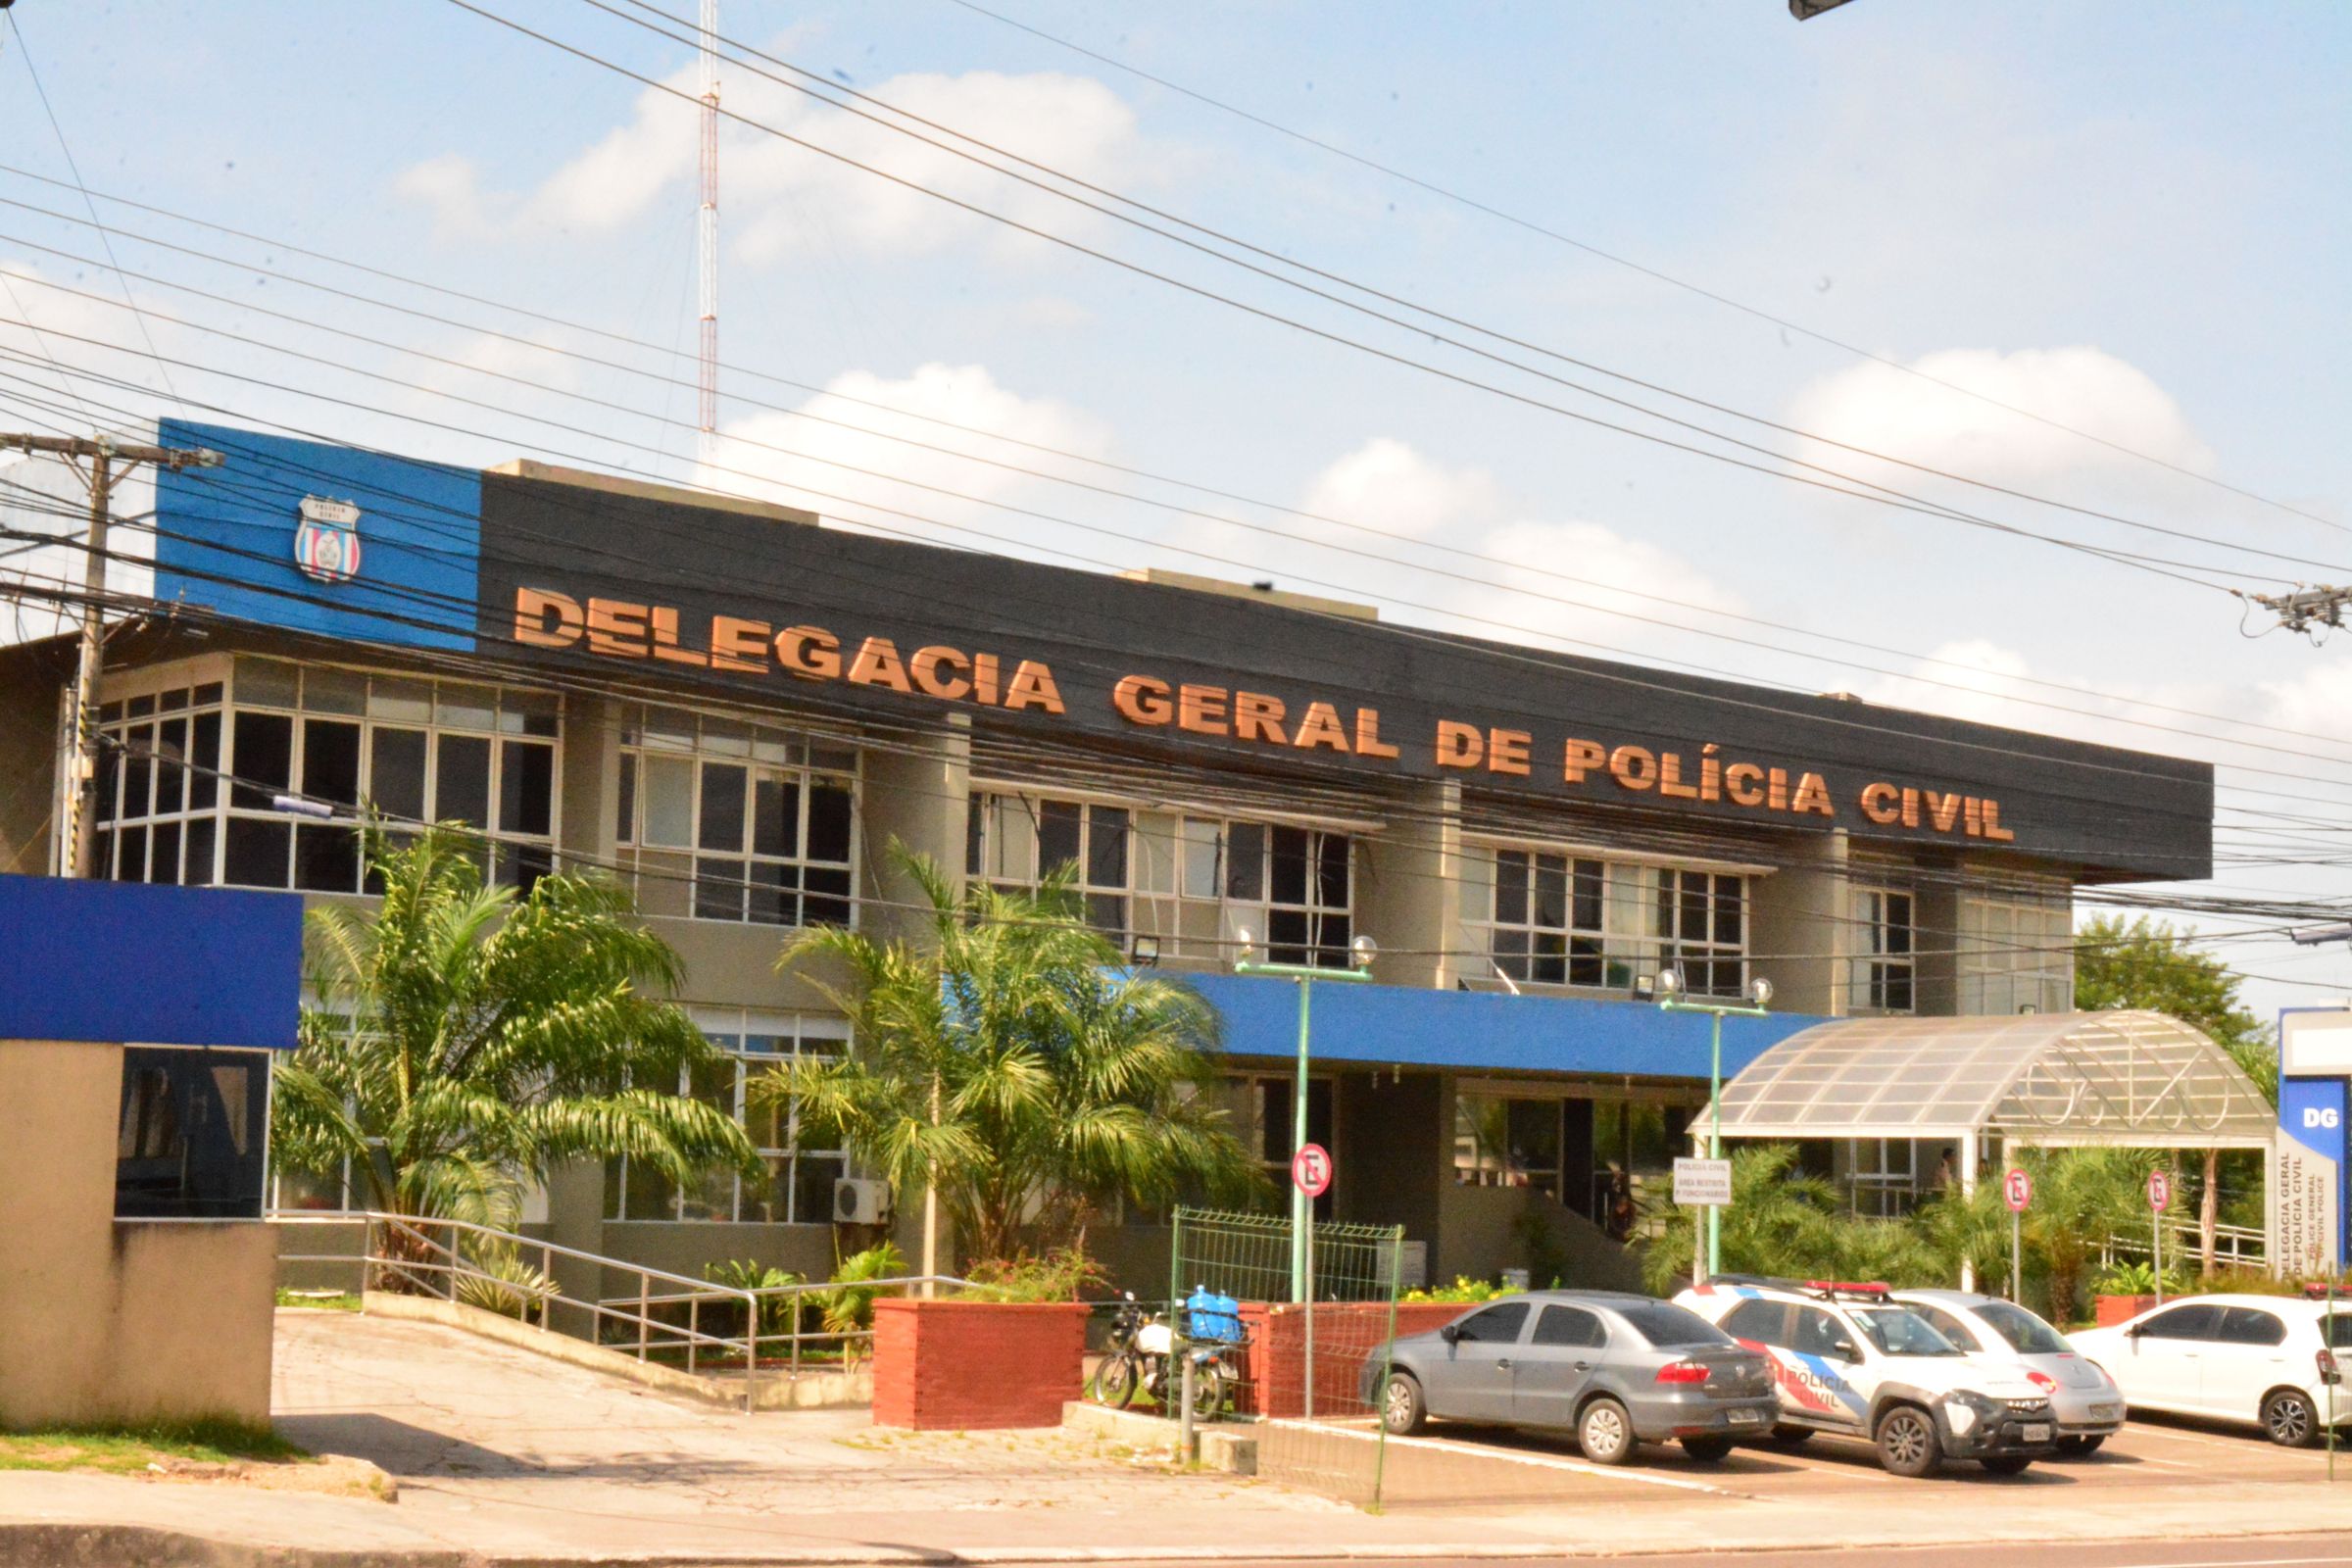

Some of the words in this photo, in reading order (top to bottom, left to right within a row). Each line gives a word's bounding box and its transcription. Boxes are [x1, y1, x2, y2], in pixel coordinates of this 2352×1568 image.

[514, 586, 1066, 714] DELEGACIA
[1113, 674, 1399, 760] GERAL
[1437, 719, 1533, 776] DE
[1565, 738, 1836, 817] POLÍCIA
[1862, 782, 2015, 842] CIVIL
[2303, 1106, 2339, 1128] DG
[2280, 1152, 2290, 1198] GERAL
[2293, 1157, 2302, 1194] CIVIL
[2280, 1201, 2290, 1280] DELEGACIA
[2293, 1257, 2303, 1276] DE
[1800, 1389, 1839, 1408] CIVIL
